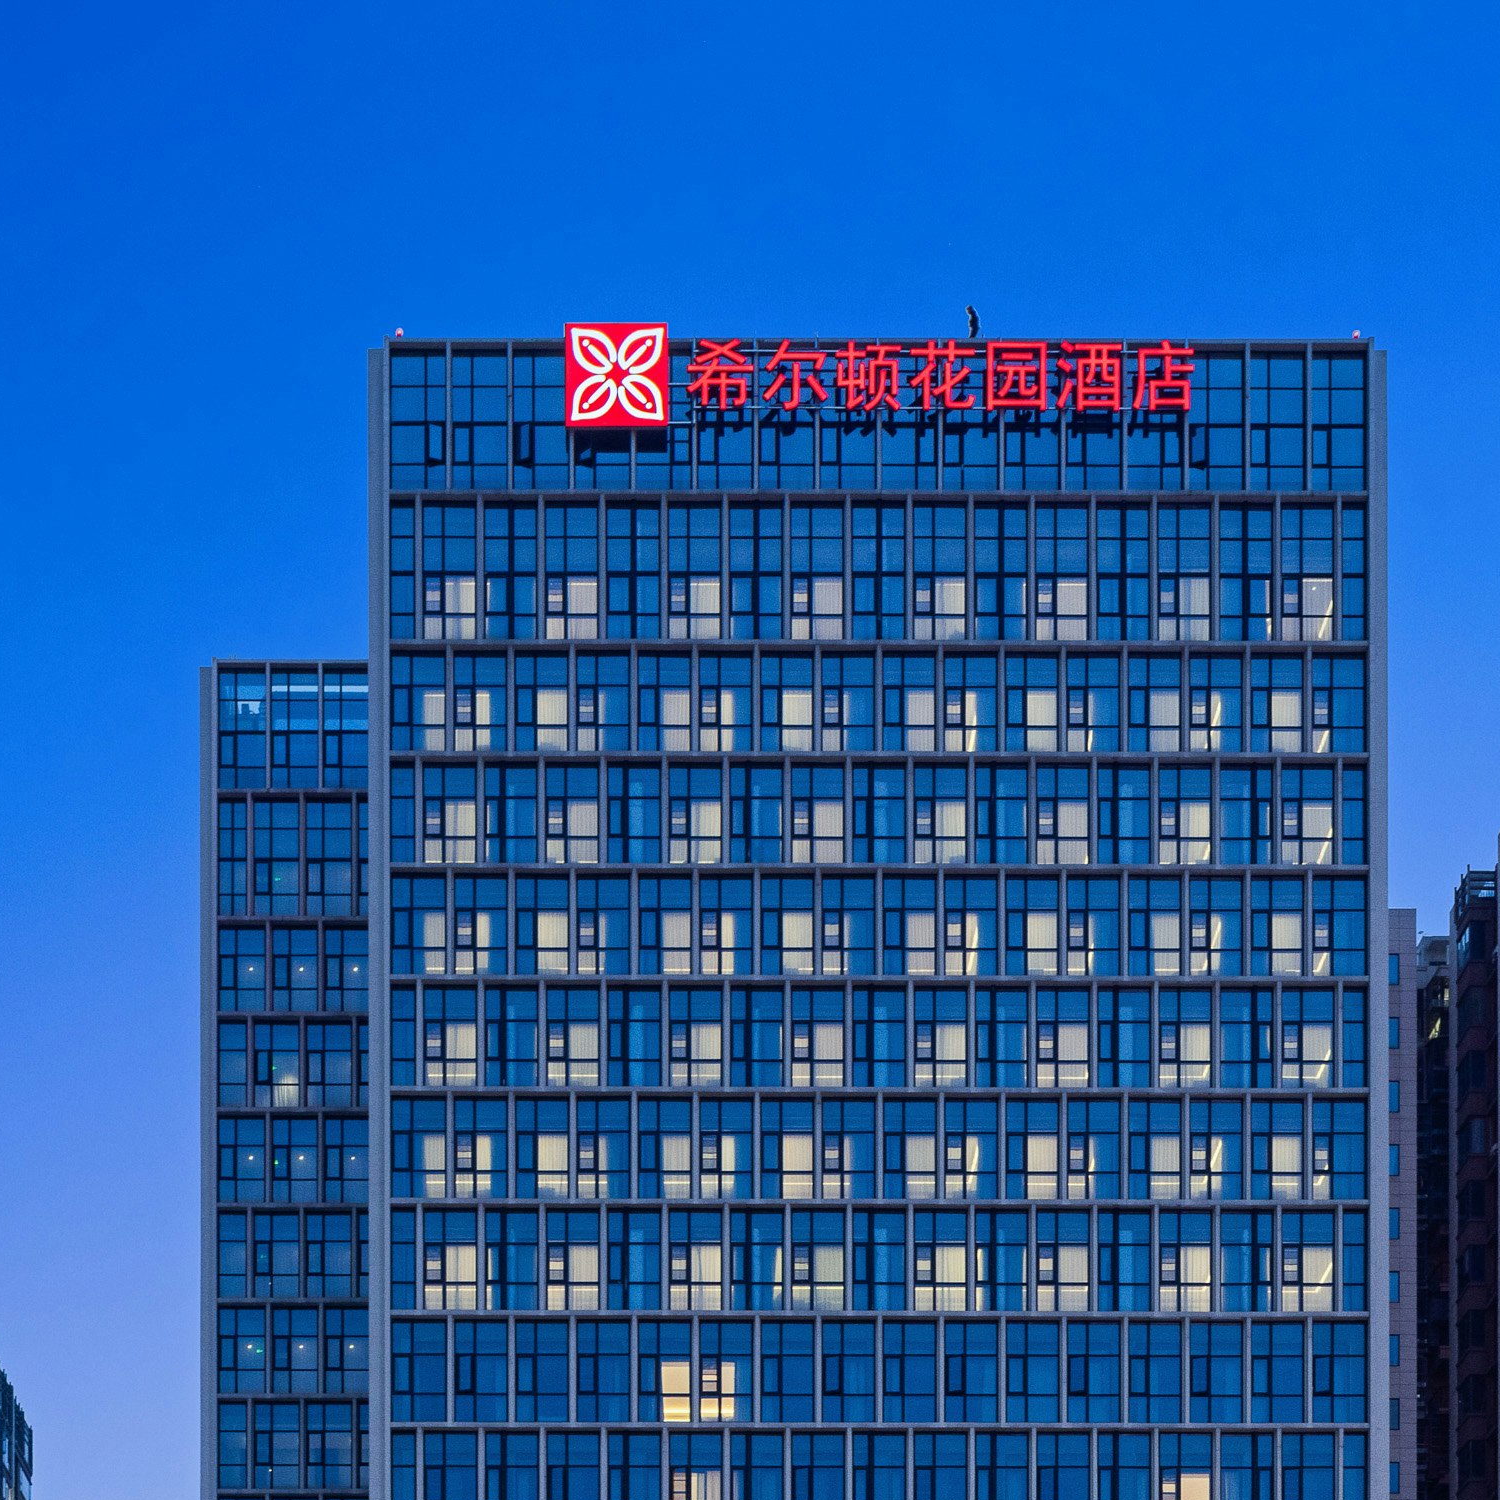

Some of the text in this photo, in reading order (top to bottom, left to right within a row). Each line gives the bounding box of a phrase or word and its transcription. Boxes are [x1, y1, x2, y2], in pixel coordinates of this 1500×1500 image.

[686, 337, 1196, 412] 希尔顿花园酒店
